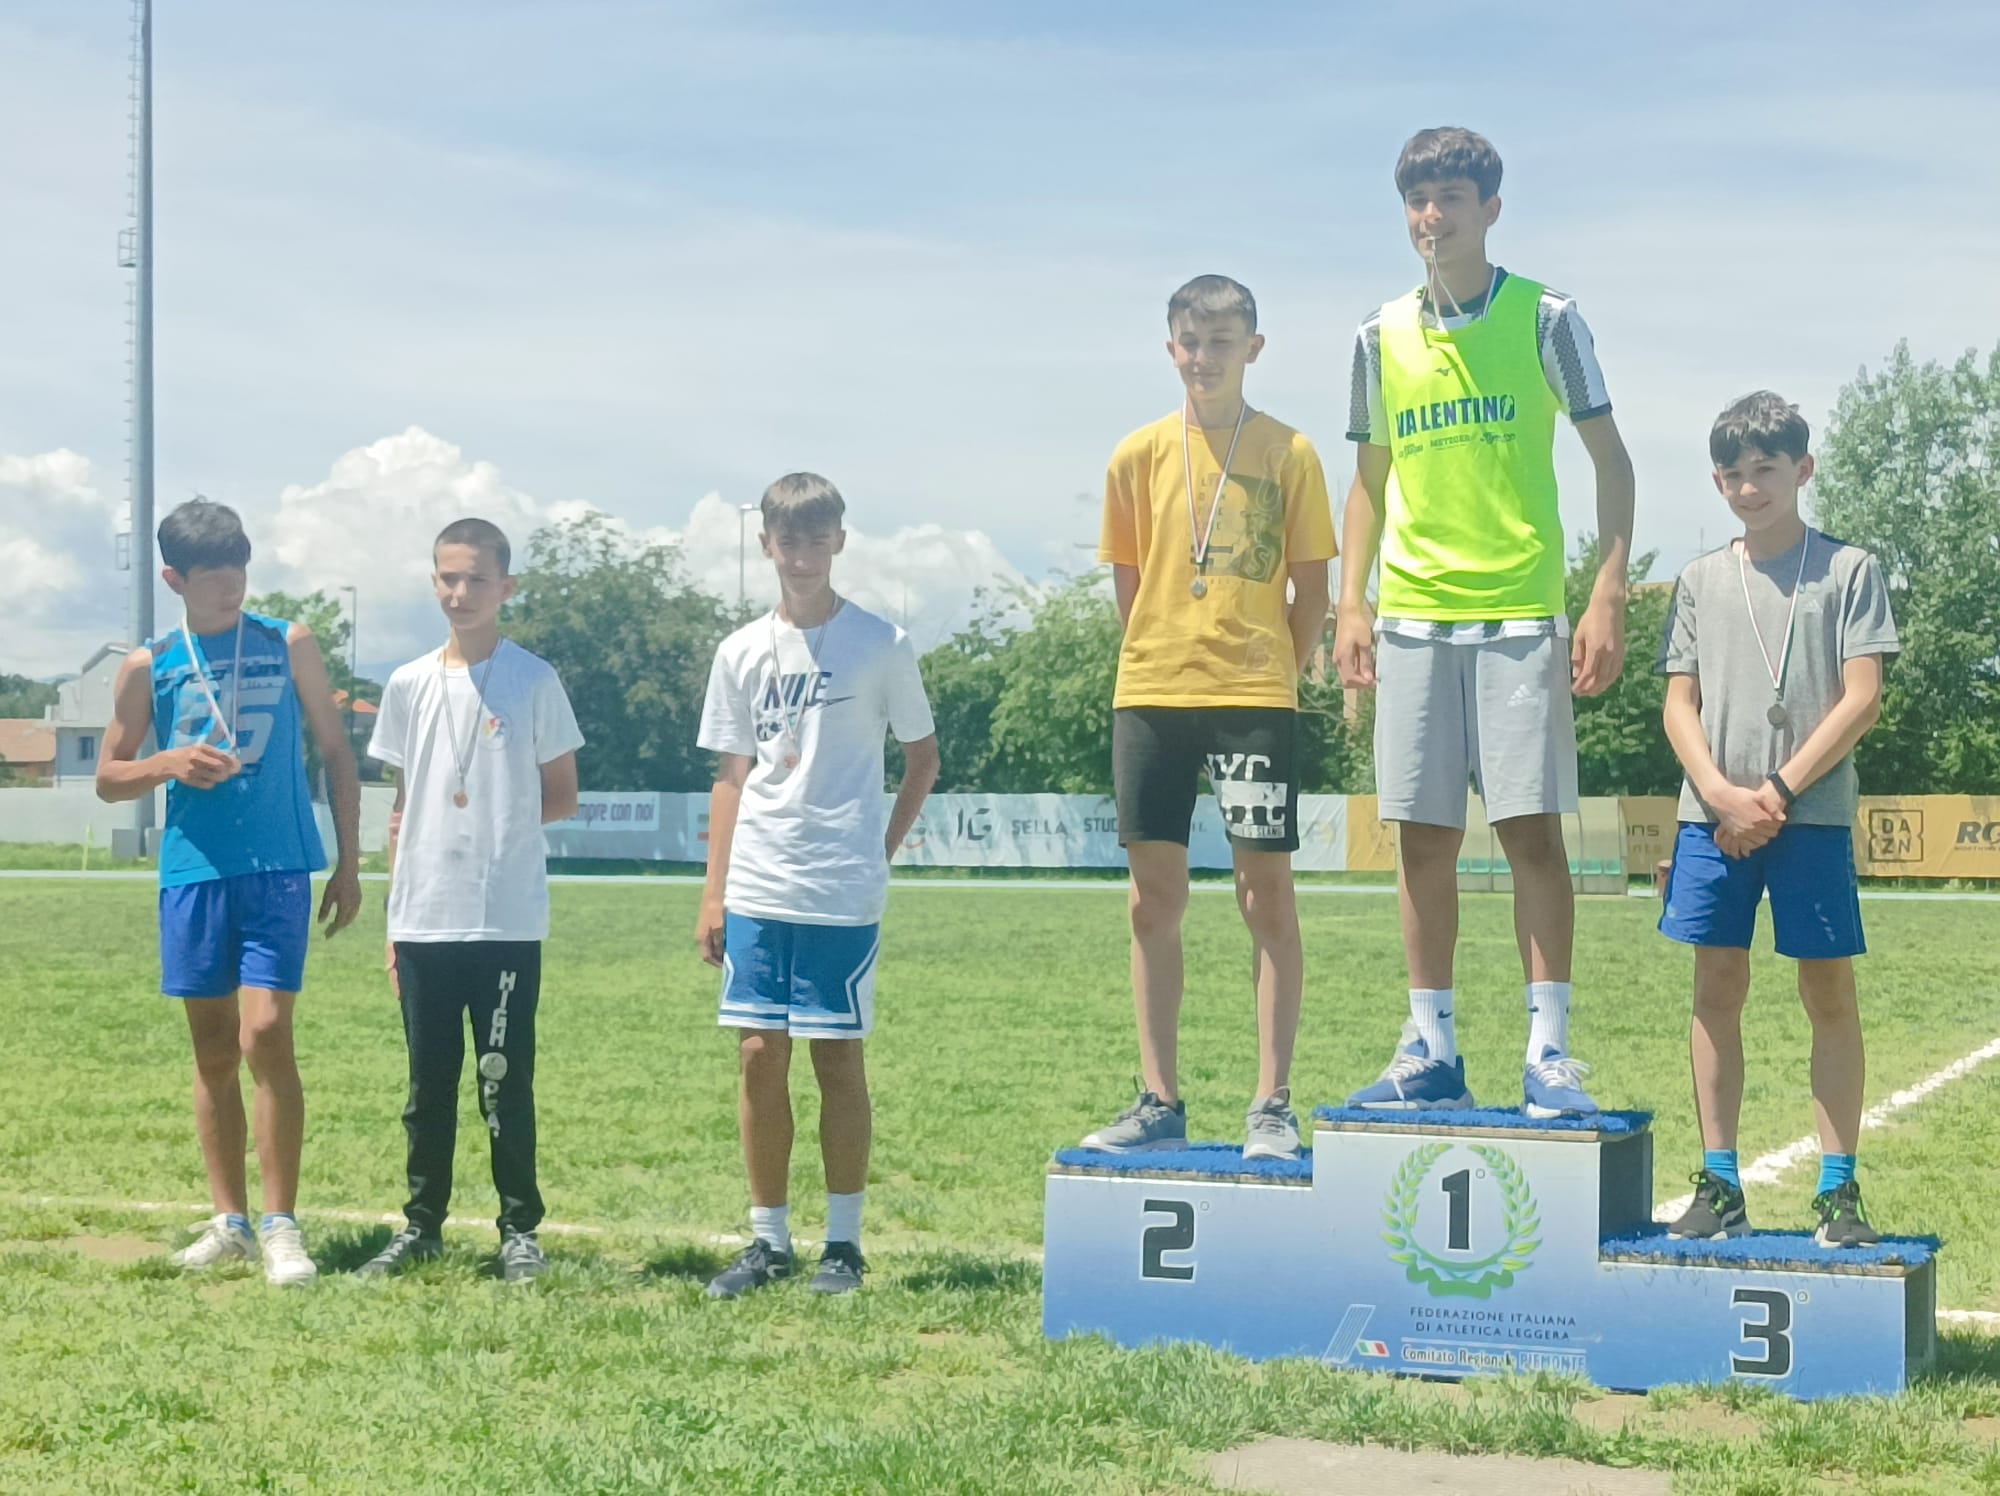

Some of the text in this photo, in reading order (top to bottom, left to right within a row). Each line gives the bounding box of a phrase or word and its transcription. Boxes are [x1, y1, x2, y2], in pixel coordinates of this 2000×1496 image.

[1396, 394, 1515, 439] VALENTINO
[1011, 819, 1068, 836] SELLA
[489, 971, 517, 1047] HIGH
[1410, 1306, 1577, 1327] FEDERAZIONE ITALIANA
[1416, 1321, 1571, 1341] DI ATLETICA LEGGERA
[1402, 1345, 1455, 1364] Comitato
